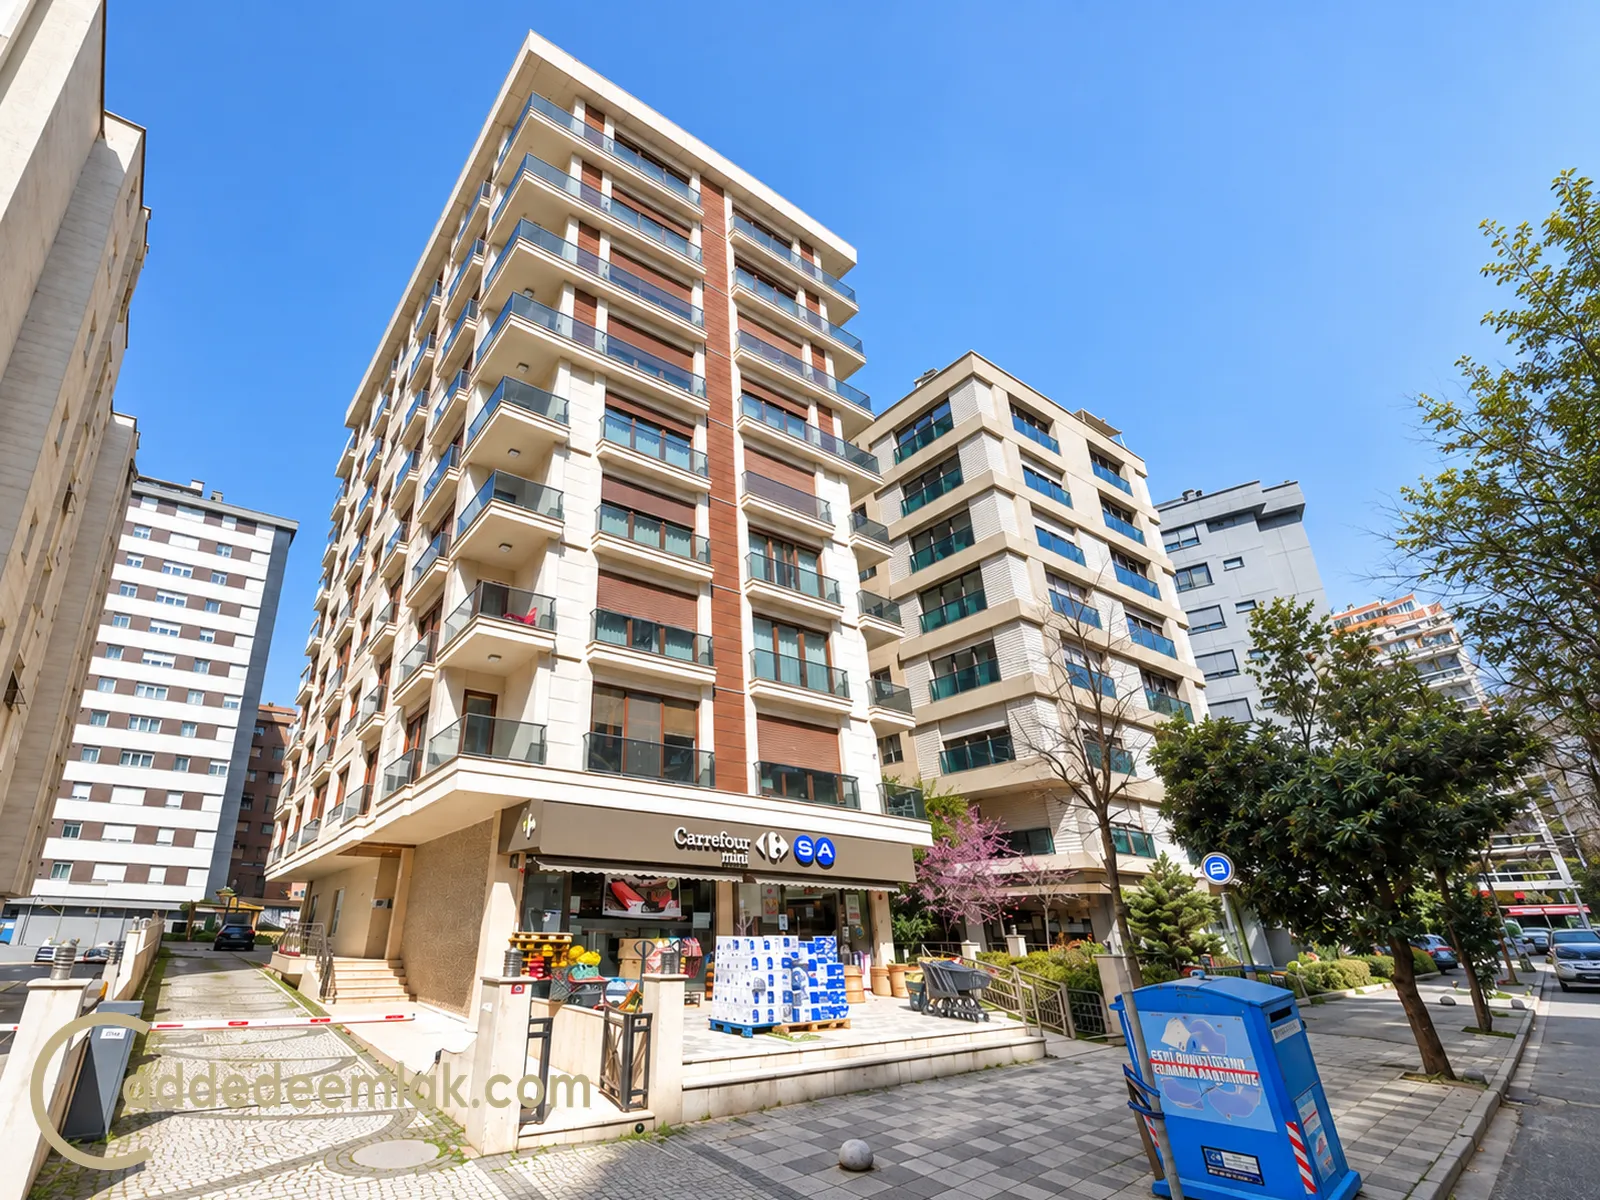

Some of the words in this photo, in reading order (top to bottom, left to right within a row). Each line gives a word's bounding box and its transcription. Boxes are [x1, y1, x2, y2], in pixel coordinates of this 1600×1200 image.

[674, 827, 751, 850] Carrefour
[721, 849, 749, 864] mini
[796, 839, 834, 860] SA
